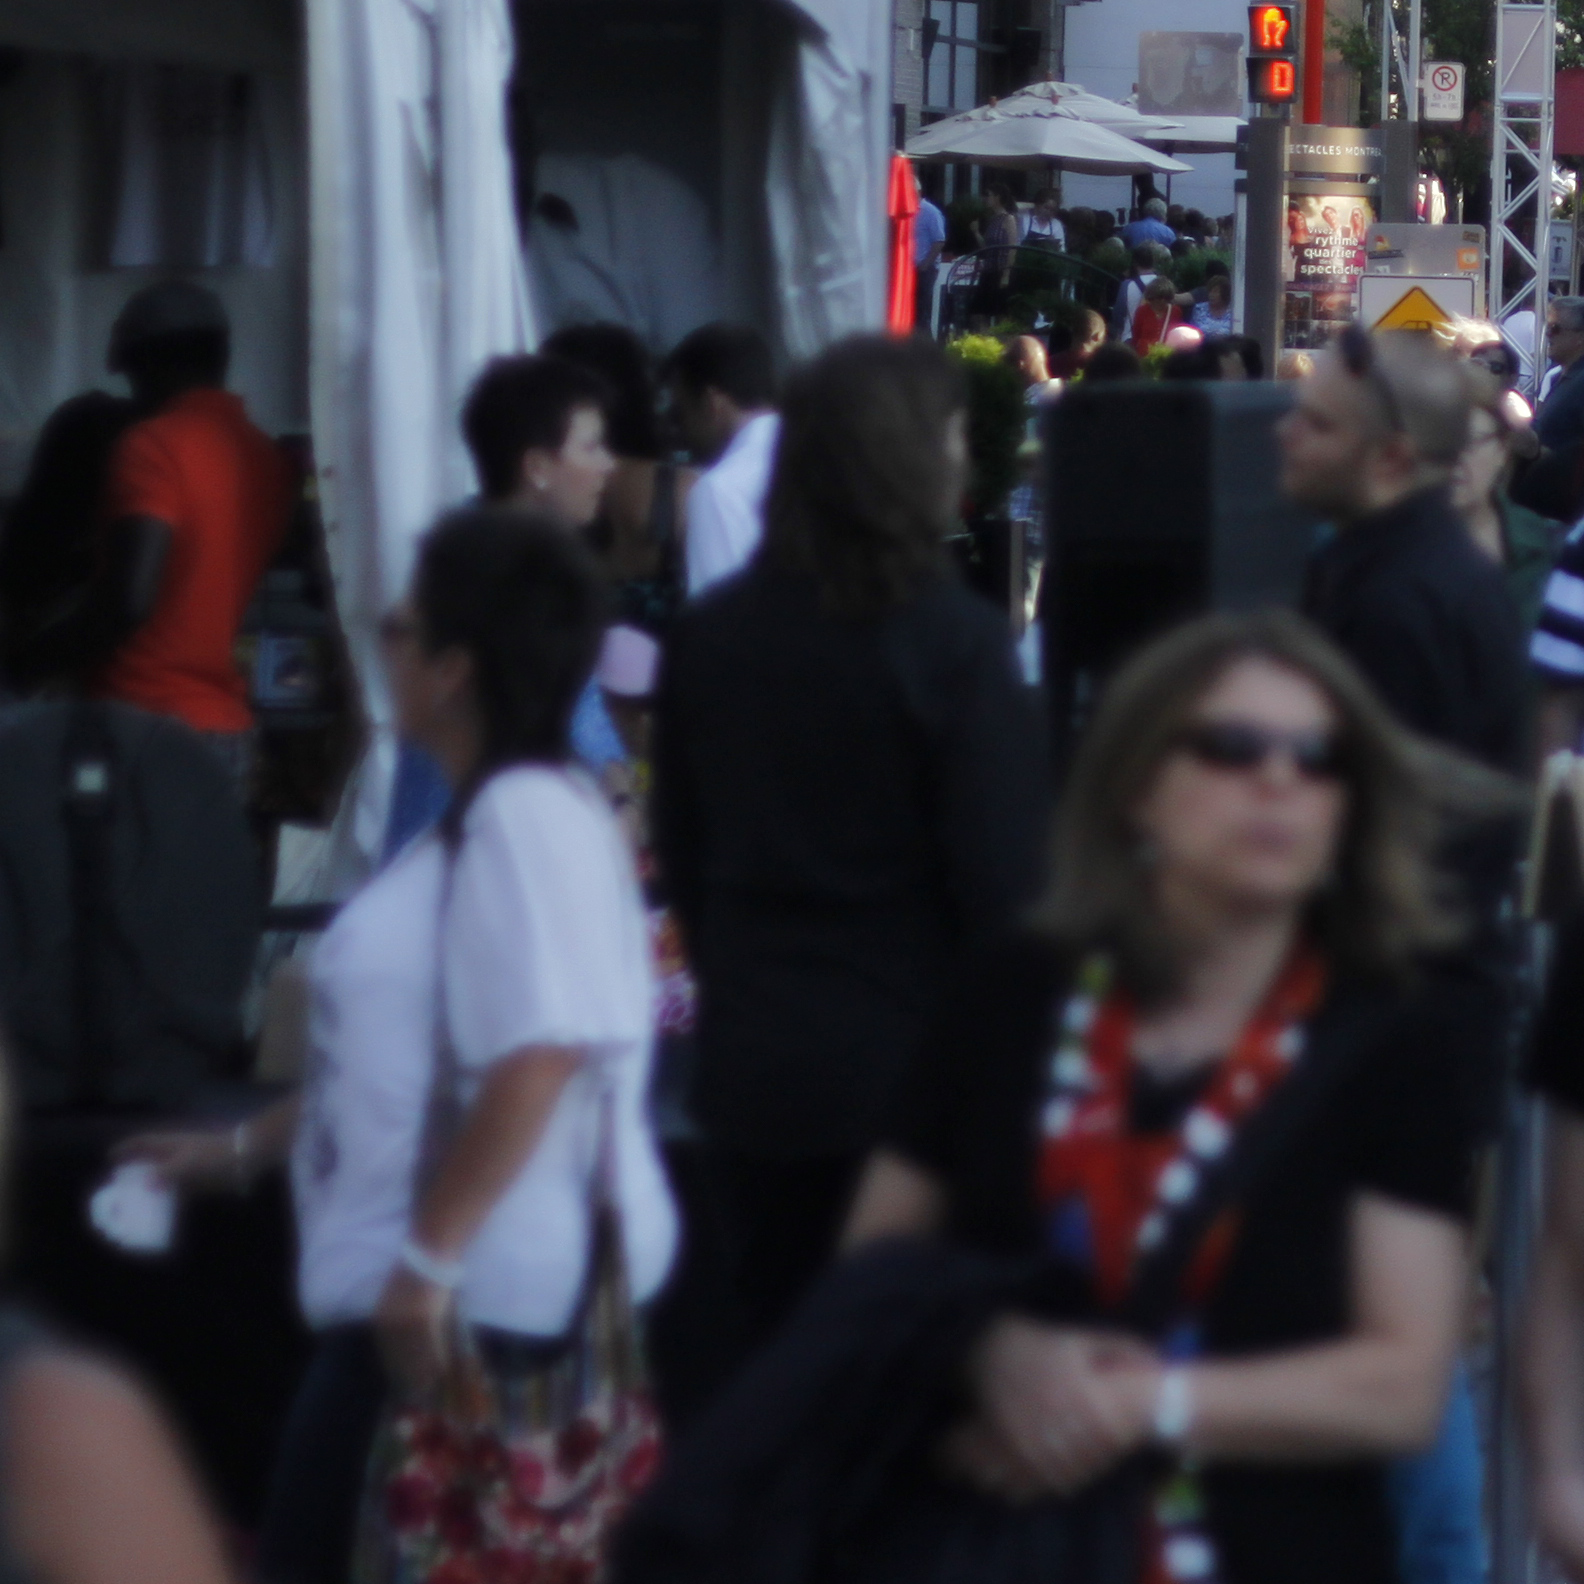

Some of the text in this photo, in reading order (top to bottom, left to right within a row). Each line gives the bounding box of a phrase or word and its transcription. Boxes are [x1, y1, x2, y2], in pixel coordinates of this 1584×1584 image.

[1288, 144, 1341, 156] ECTACLES
[1315, 235, 1358, 247] rythme
[1304, 247, 1357, 260] quartier
[1300, 263, 1364, 276] spectacles
